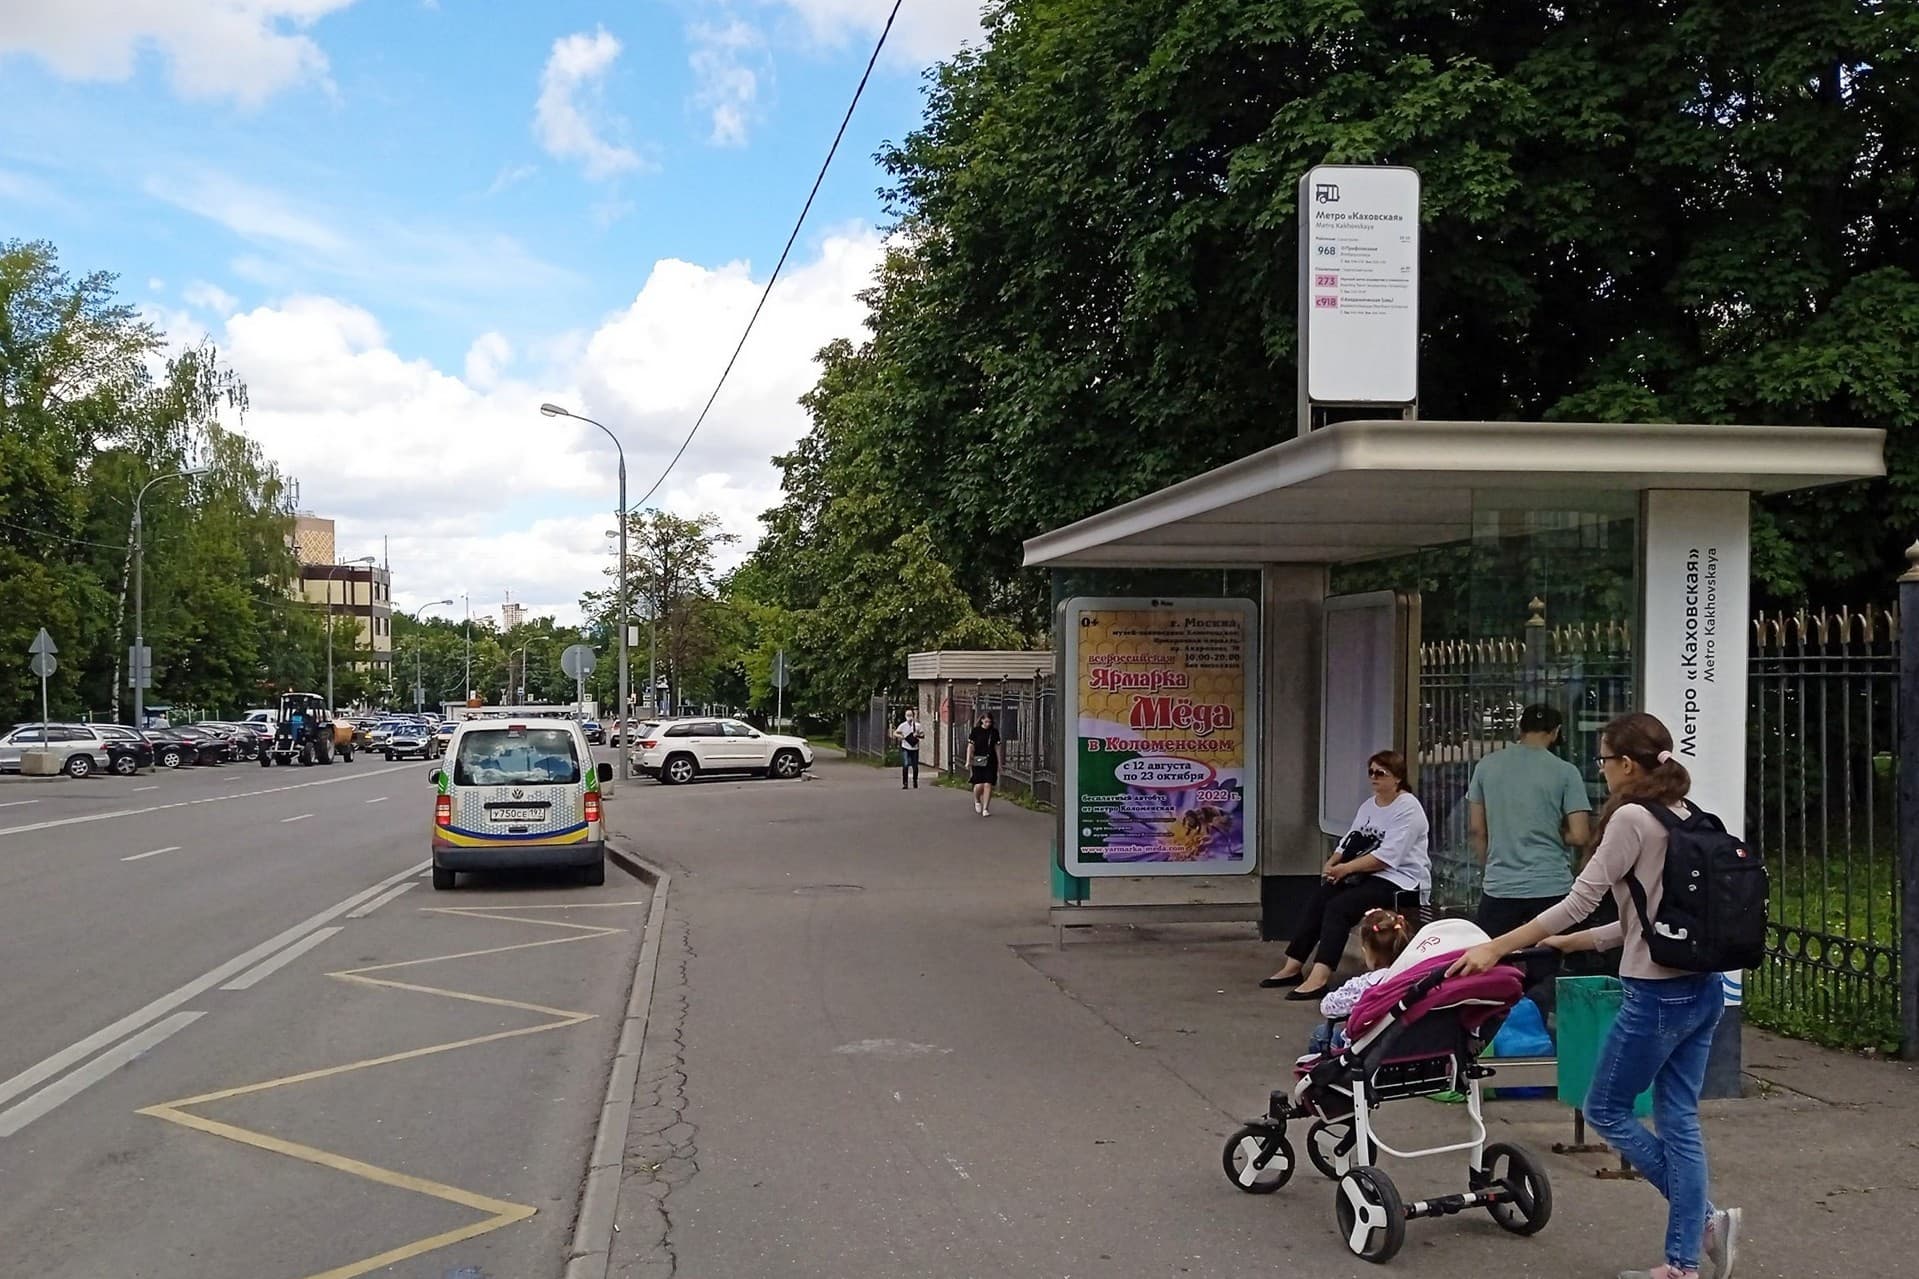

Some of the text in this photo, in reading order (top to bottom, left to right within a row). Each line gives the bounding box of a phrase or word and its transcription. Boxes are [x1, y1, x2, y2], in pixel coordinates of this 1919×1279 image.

[1316, 211, 1403, 221] Метро «Каховская»
[1318, 246, 1336, 256] 968
[1318, 277, 1336, 286] 273
[1316, 297, 1337, 306] с918
[1081, 617, 1099, 627] 0+
[1704, 548, 1719, 683] Metro Kakhovskaya
[1680, 549, 1700, 757] Метро «Каховская»
[1089, 668, 1188, 692] Ярмарка
[1130, 695, 1233, 736] Мёда
[1088, 737, 1234, 752] в Коломенском
[1133, 761, 1145, 770] 12
[1147, 762, 1192, 774] августа
[1123, 771, 1205, 784] по 23 октября
[1197, 791, 1241, 801] 2022 г.
